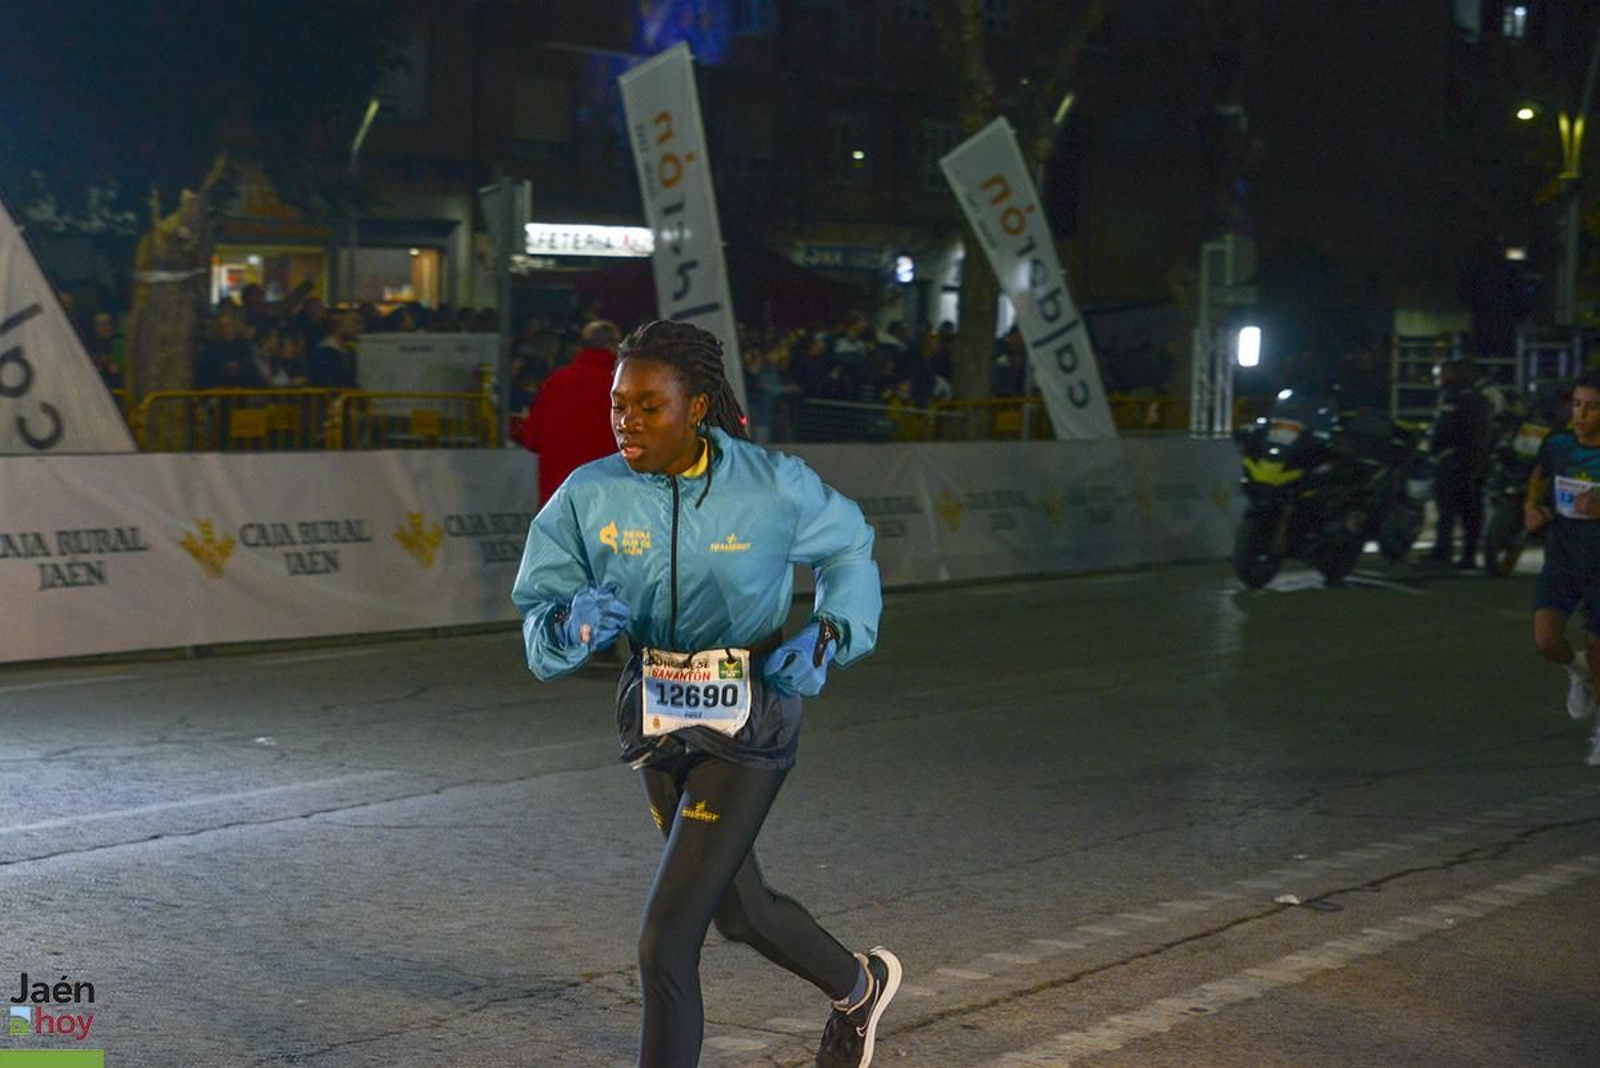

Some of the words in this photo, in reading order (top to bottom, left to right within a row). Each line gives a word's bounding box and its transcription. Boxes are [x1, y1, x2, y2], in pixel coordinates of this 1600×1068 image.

[527, 231, 615, 251] FETERIA
[0, 531, 52, 559] AJA
[54, 526, 152, 556] RURAL
[238, 522, 297, 549] CAJA
[298, 518, 373, 545] RURAL
[38, 558, 107, 591] JAÉN
[283, 547, 343, 576] JAÉN
[655, 682, 739, 708] 12690
